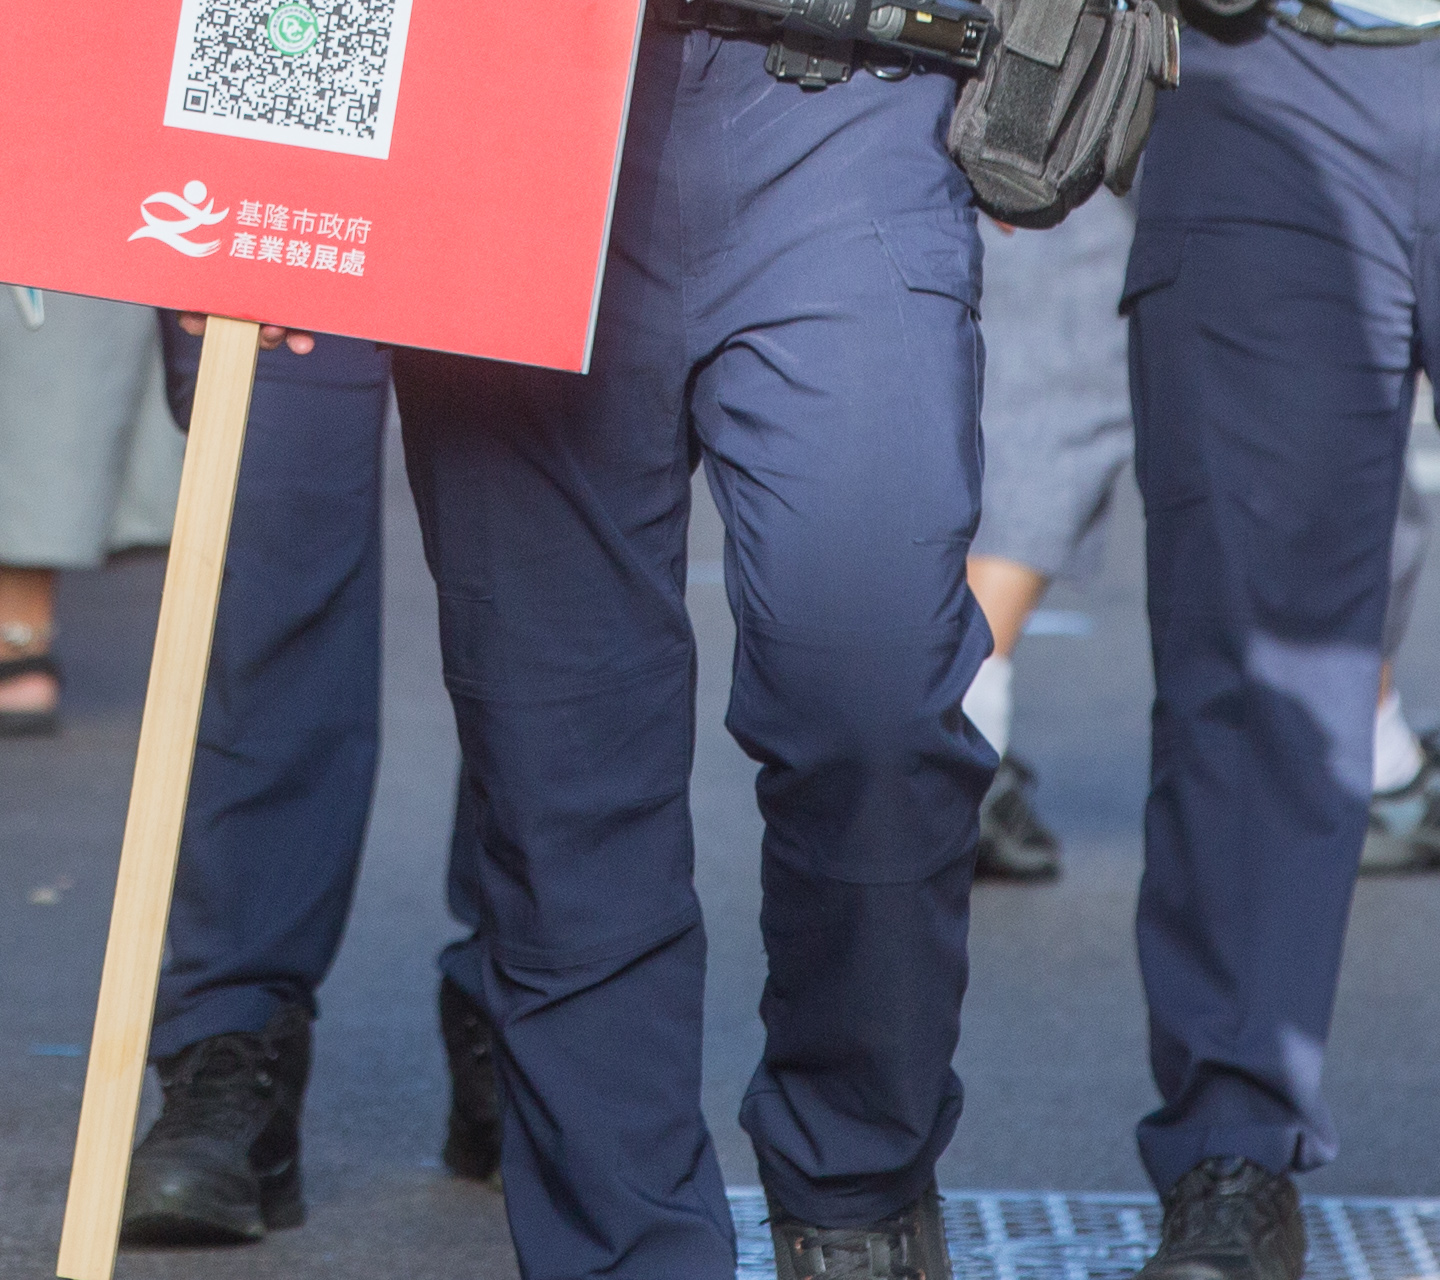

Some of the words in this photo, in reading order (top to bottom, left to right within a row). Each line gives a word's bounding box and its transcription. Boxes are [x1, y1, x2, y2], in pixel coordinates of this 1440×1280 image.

[236, 199, 372, 244] 基隆市政府
[229, 232, 366, 277] 產業發展處
